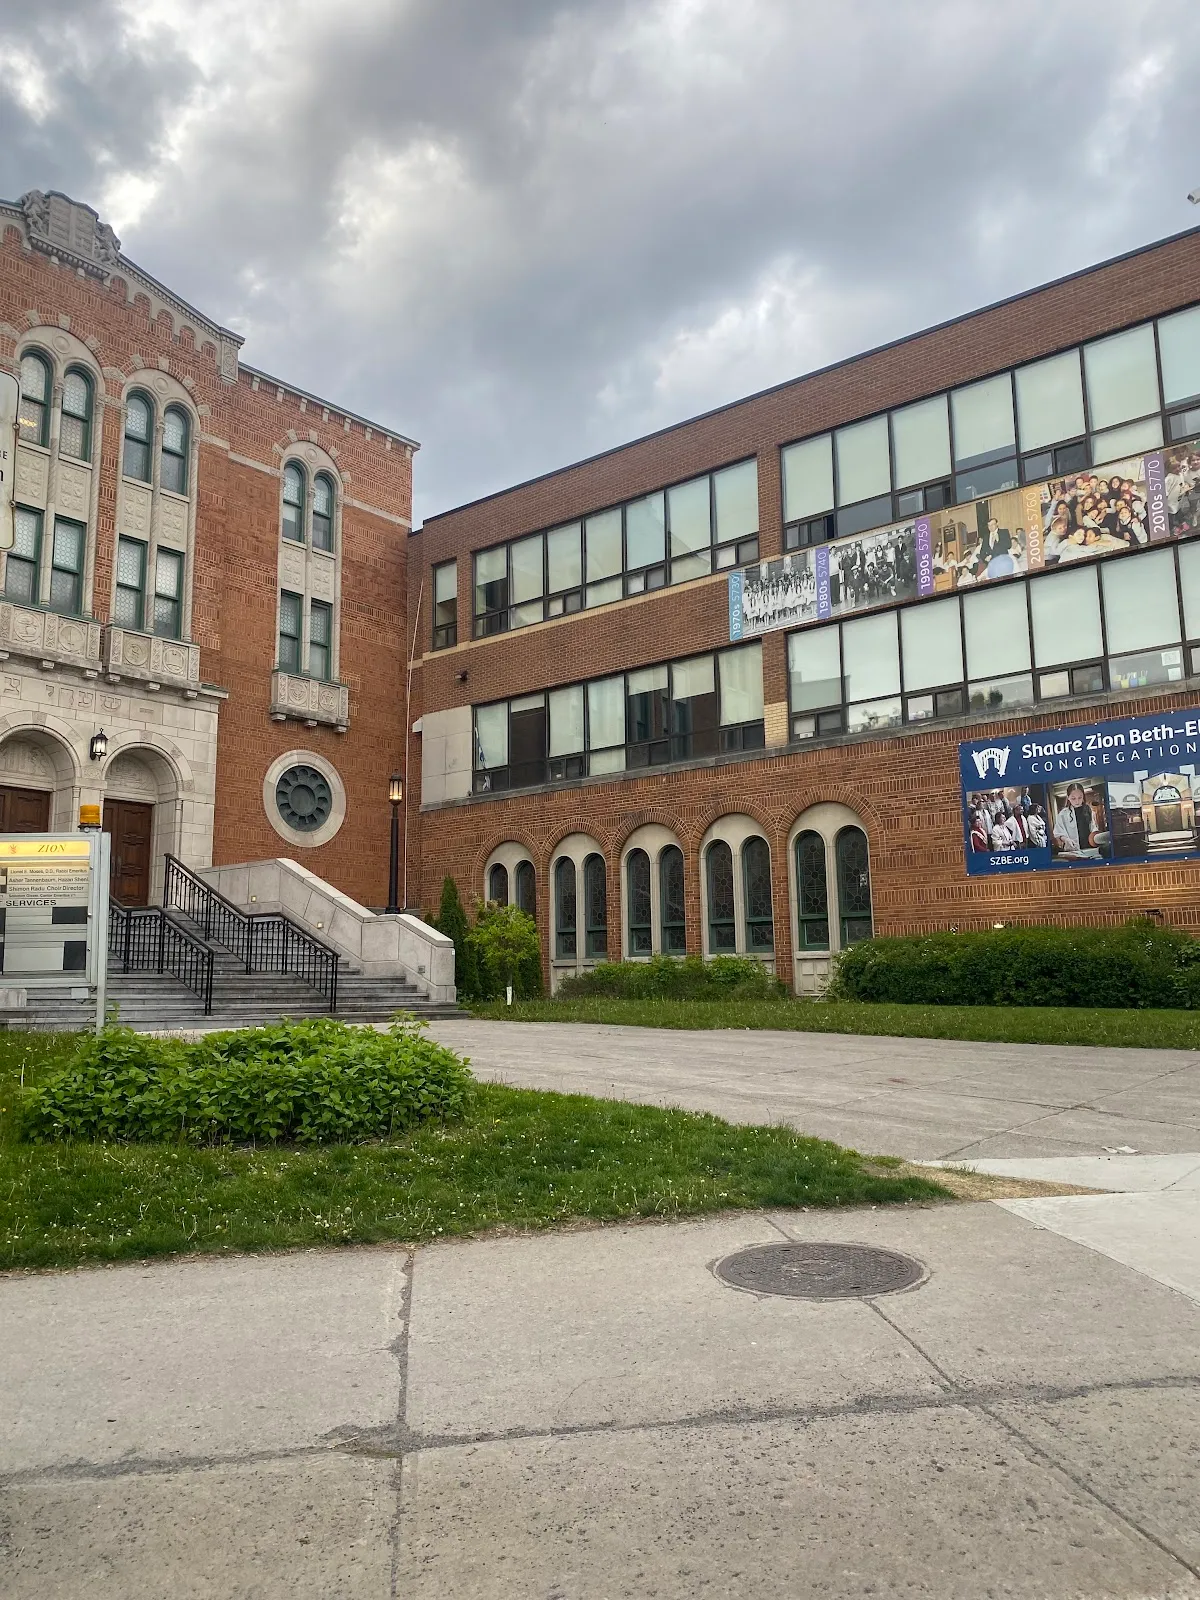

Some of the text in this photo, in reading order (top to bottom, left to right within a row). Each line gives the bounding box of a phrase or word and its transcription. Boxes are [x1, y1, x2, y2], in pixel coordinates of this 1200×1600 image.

[1148, 460, 1166, 532] 2010s 5770
[918, 524, 930, 589] 1990s 5750
[1026, 492, 1040, 564] 2000s 5760
[732, 575, 740, 634] 1970s 5730
[818, 552, 828, 614] 1980s 5740
[1021, 739, 1082, 759] Shaare
[1086, 732, 1125, 750] Zion
[1031, 742, 1197, 774] CONGREGATION
[38, 844, 66, 852] ZION
[990, 855, 1028, 866] SZBE.org
